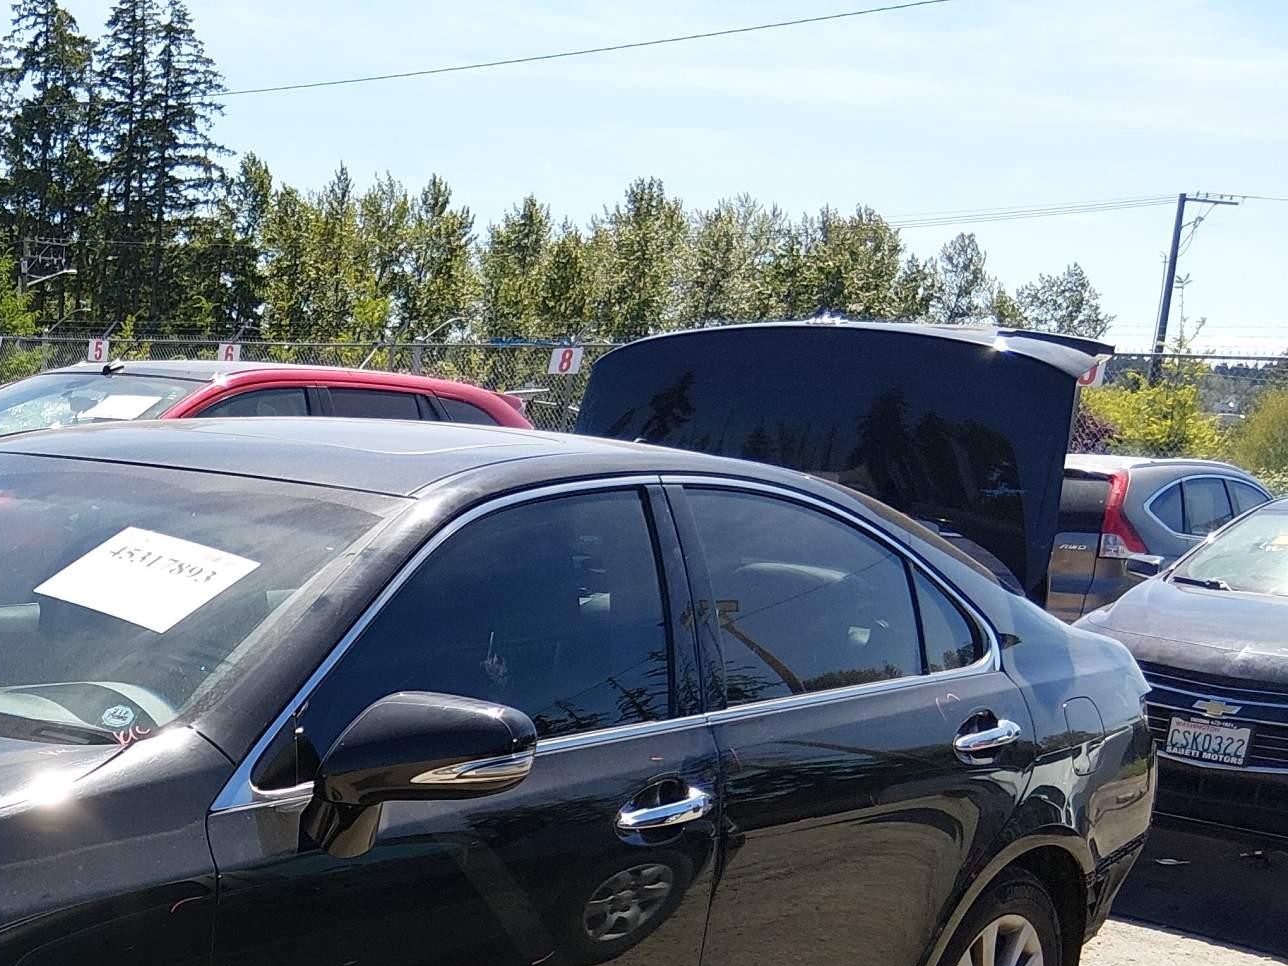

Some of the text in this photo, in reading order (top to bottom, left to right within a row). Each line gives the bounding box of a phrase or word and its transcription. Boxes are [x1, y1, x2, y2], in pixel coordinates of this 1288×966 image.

[94, 341, 103, 361] 5
[224, 345, 234, 361] 6
[558, 349, 574, 372] 8
[1171, 728, 1245, 757] CSK0322
[1201, 752, 1244, 765] MOTORS
